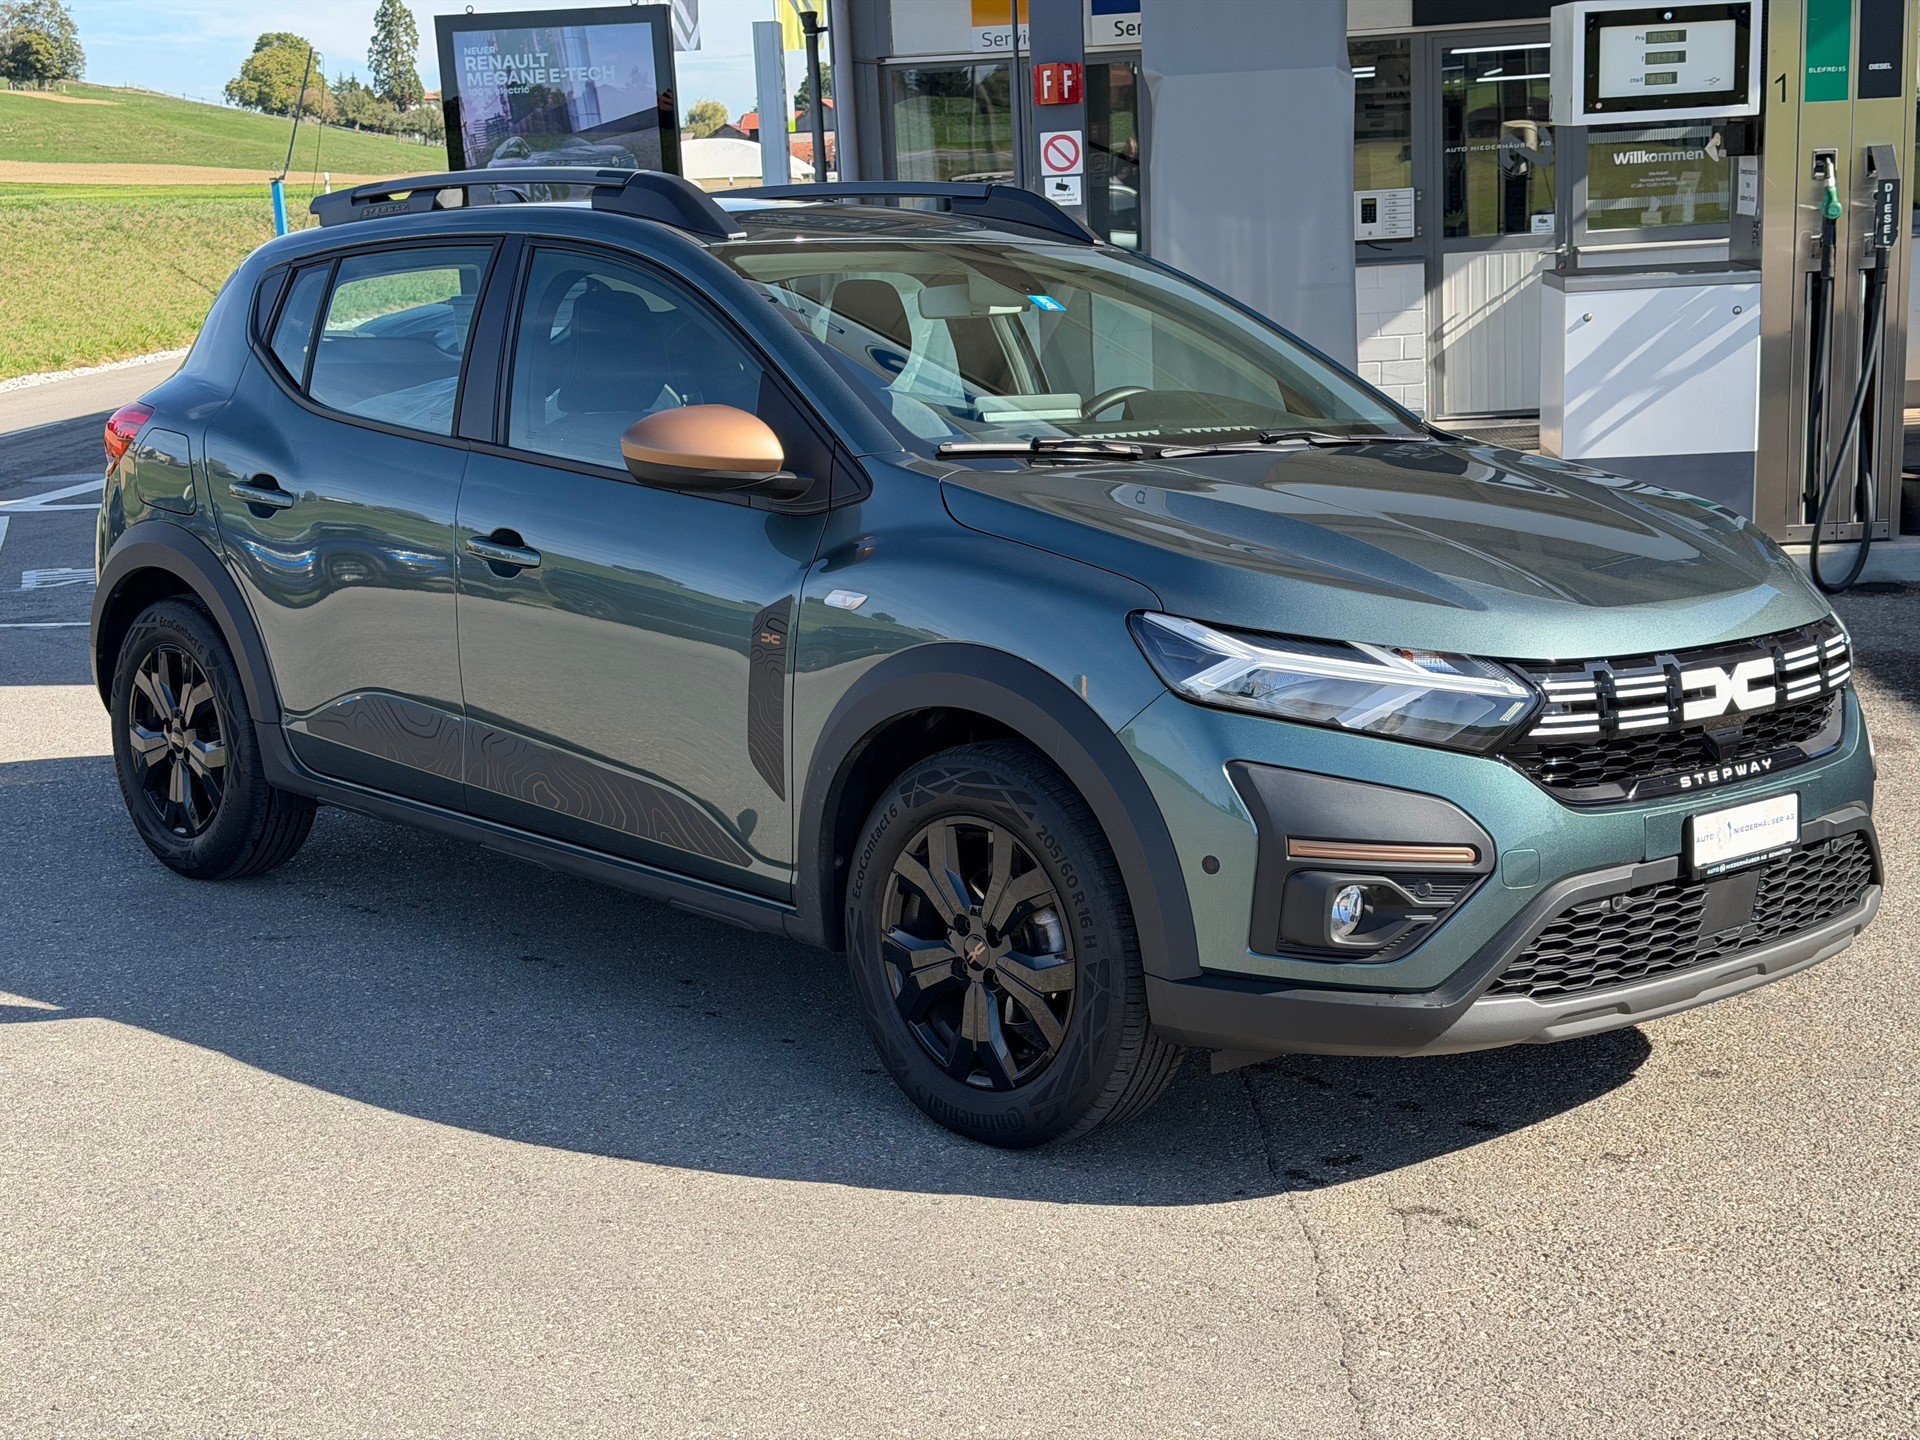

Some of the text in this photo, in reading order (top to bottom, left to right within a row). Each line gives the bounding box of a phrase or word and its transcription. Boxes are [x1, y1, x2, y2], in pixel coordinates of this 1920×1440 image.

[463, 46, 496, 55] NEUER
[464, 52, 549, 71] RENAULT
[466, 65, 615, 87] MEGANE E-TECH
[1868, 62, 1893, 70] DIESEL
[495, 86, 530, 95] electric
[1042, 69, 1052, 100] F
[1063, 69, 1073, 99] F
[1774, 73, 1787, 103] 1
[1613, 149, 1705, 165] Willkommen
[362, 203, 408, 216] STEPWAY
[1882, 183, 1893, 244] DIESEL
[160, 615, 199, 649] EcoContact
[1679, 758, 1772, 788] STEPWAY
[1696, 833, 1715, 844] AUTO
[1785, 813, 1795, 821] AG
[852, 803, 898, 900] EcoContact 6
[1035, 824, 1098, 950] 205/60 R 16 H
